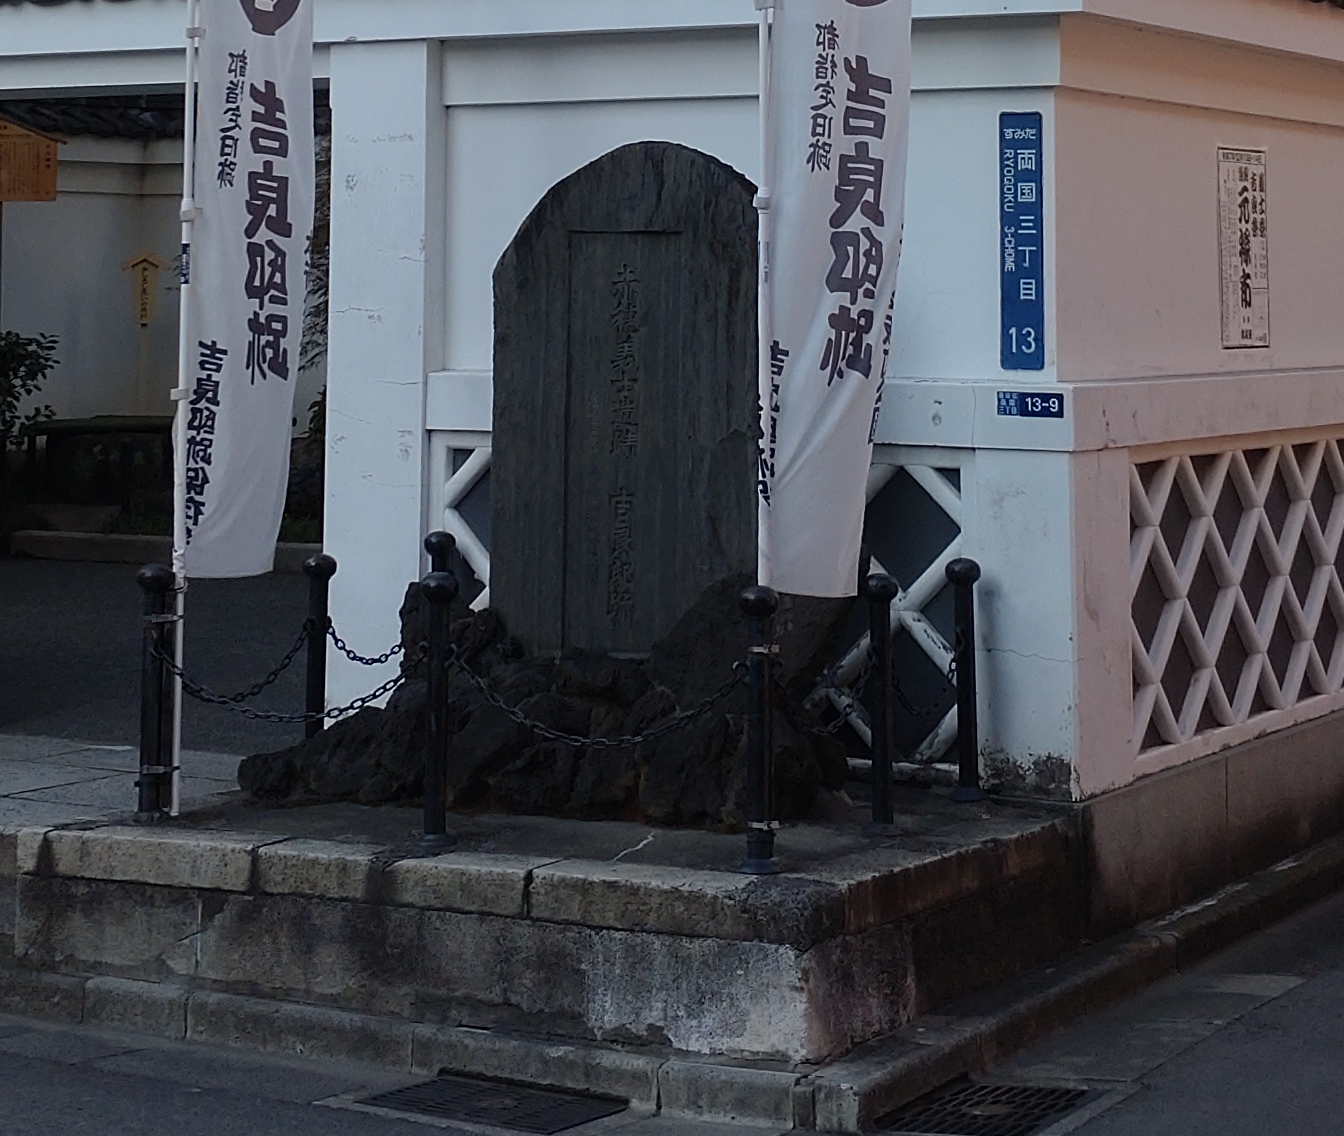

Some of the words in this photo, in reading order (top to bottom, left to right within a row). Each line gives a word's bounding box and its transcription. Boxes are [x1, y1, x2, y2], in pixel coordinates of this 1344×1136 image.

[1003, 128, 1037, 140] すみだ
[1003, 149, 1015, 212] RYOGOKU
[1016, 149, 1038, 301] 両国三丁目
[1004, 225, 1016, 272] 3-CHOME
[1009, 327, 1036, 354] 13
[1025, 397, 1059, 412] 13-9
